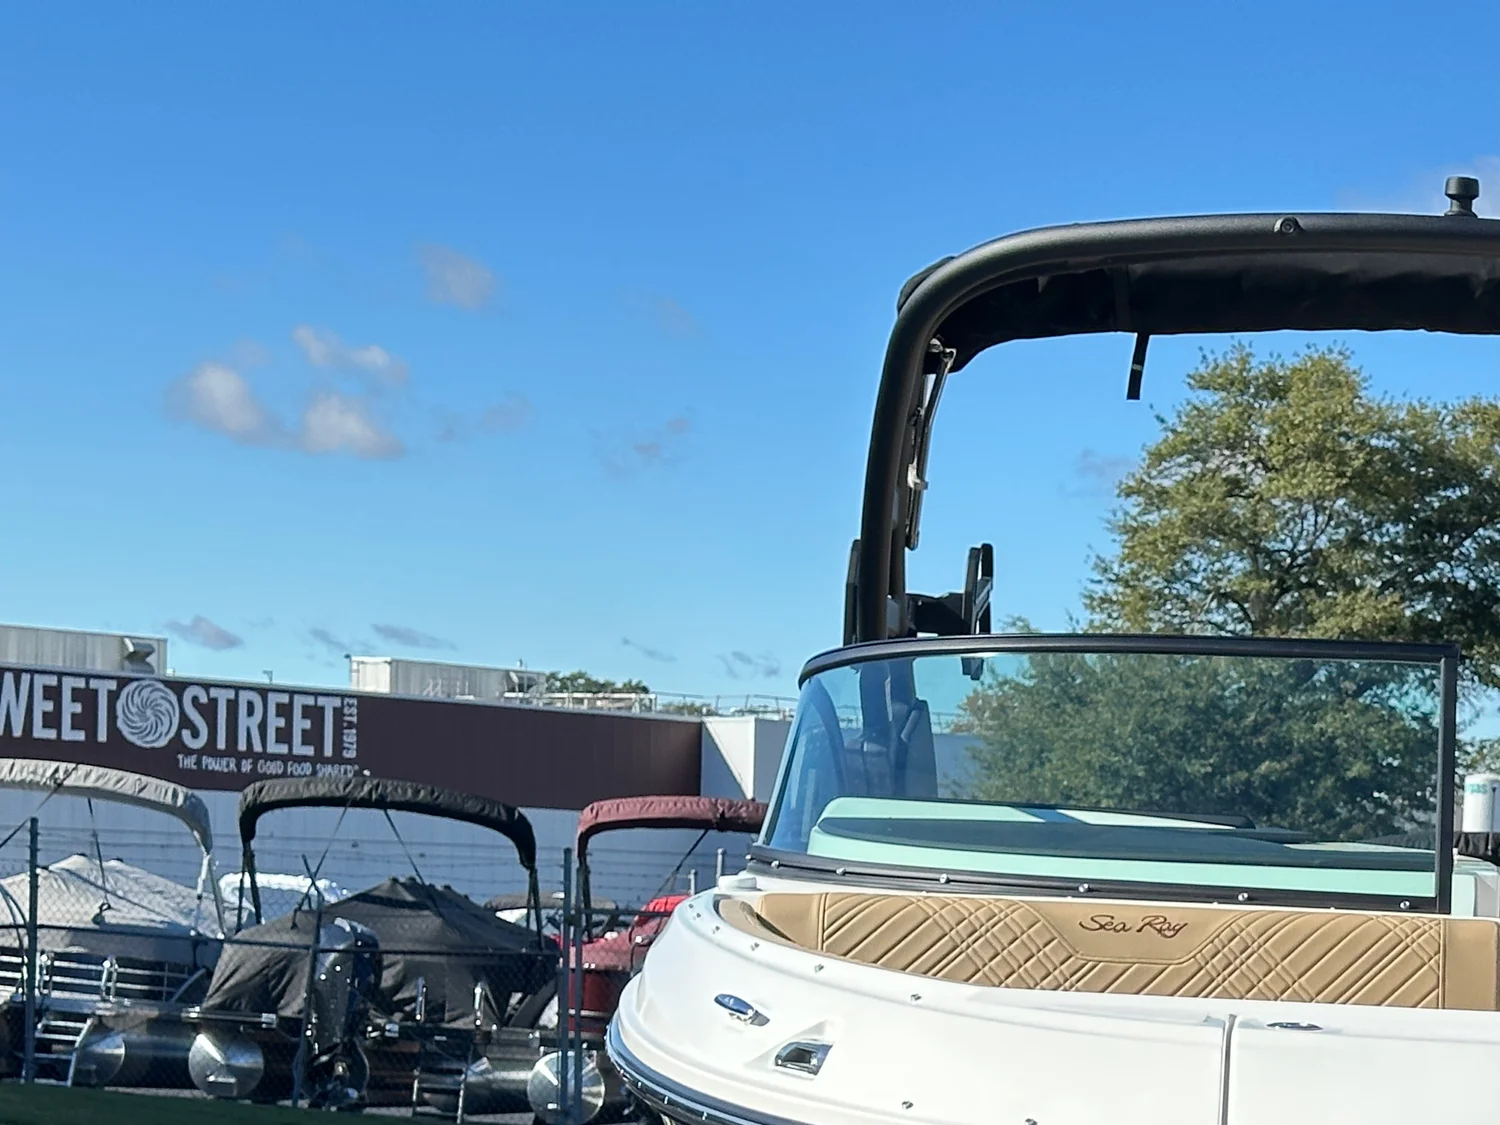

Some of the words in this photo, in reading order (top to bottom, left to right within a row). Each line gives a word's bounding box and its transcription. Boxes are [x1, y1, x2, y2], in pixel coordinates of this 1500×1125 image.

[181, 684, 342, 758] STREET
[177, 753, 198, 770] THE
[202, 755, 237, 772] POWER
[241, 758, 253, 774] OF
[257, 760, 284, 775] GOOD
[287, 761, 312, 777] FOOD
[1079, 914, 1132, 933] Sea
[1136, 914, 1188, 939] Ray
